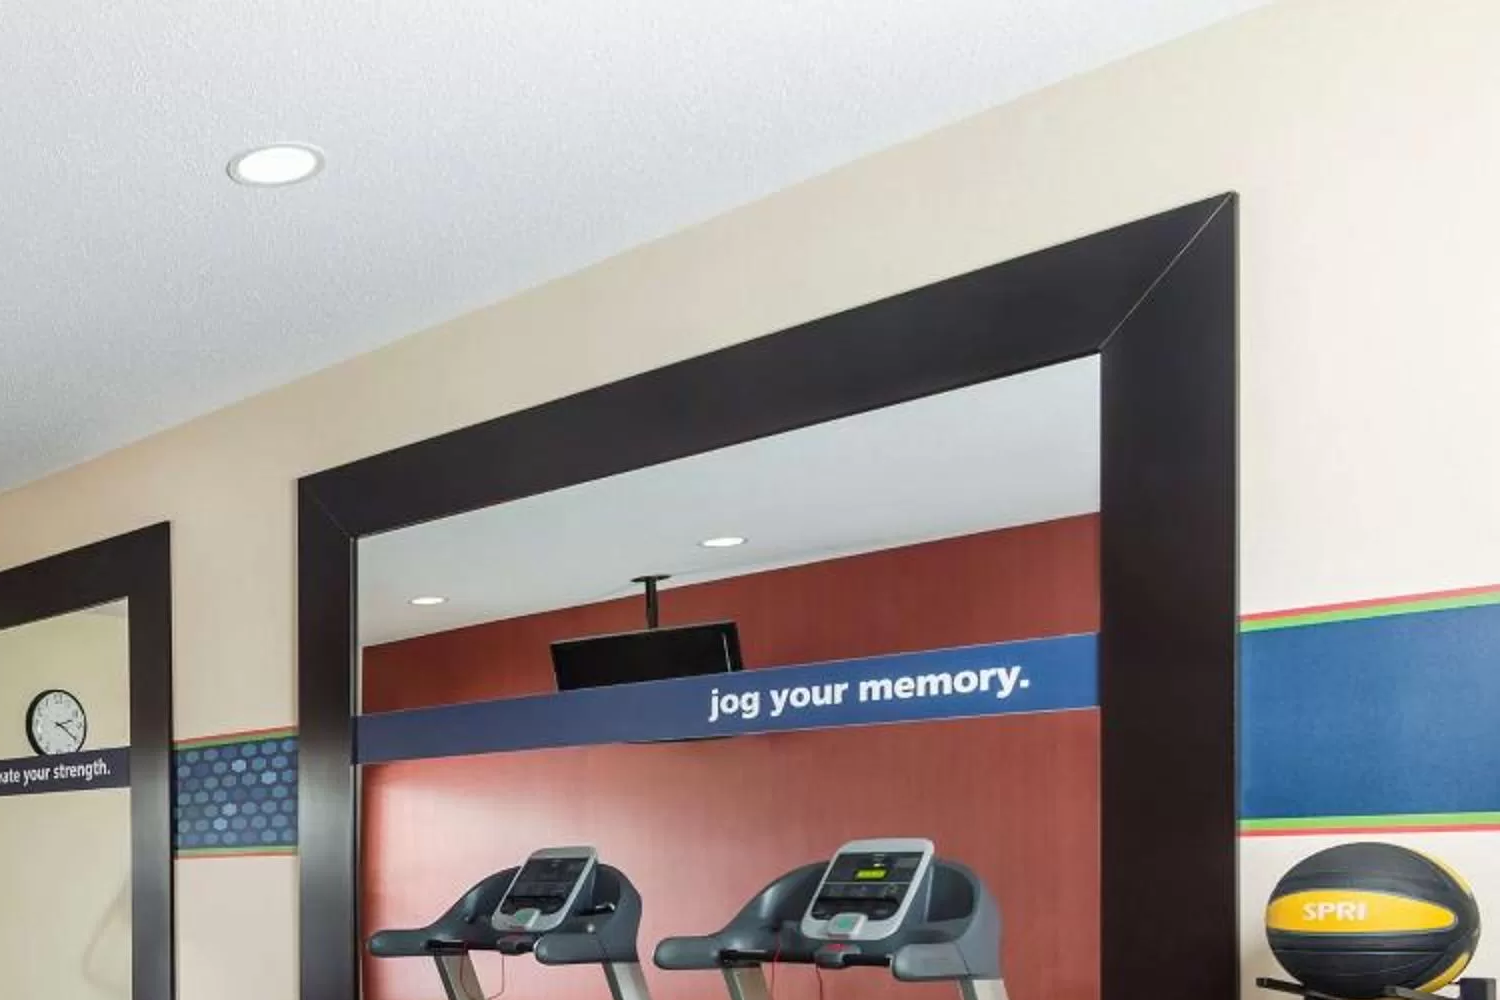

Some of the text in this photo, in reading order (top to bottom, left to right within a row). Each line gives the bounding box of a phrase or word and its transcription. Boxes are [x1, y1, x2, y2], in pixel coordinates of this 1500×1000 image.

[708, 664, 1031, 722] jog your memory.
[23, 767, 50, 787] your
[53, 757, 111, 781] strength.
[1302, 901, 1367, 921] SPRI
